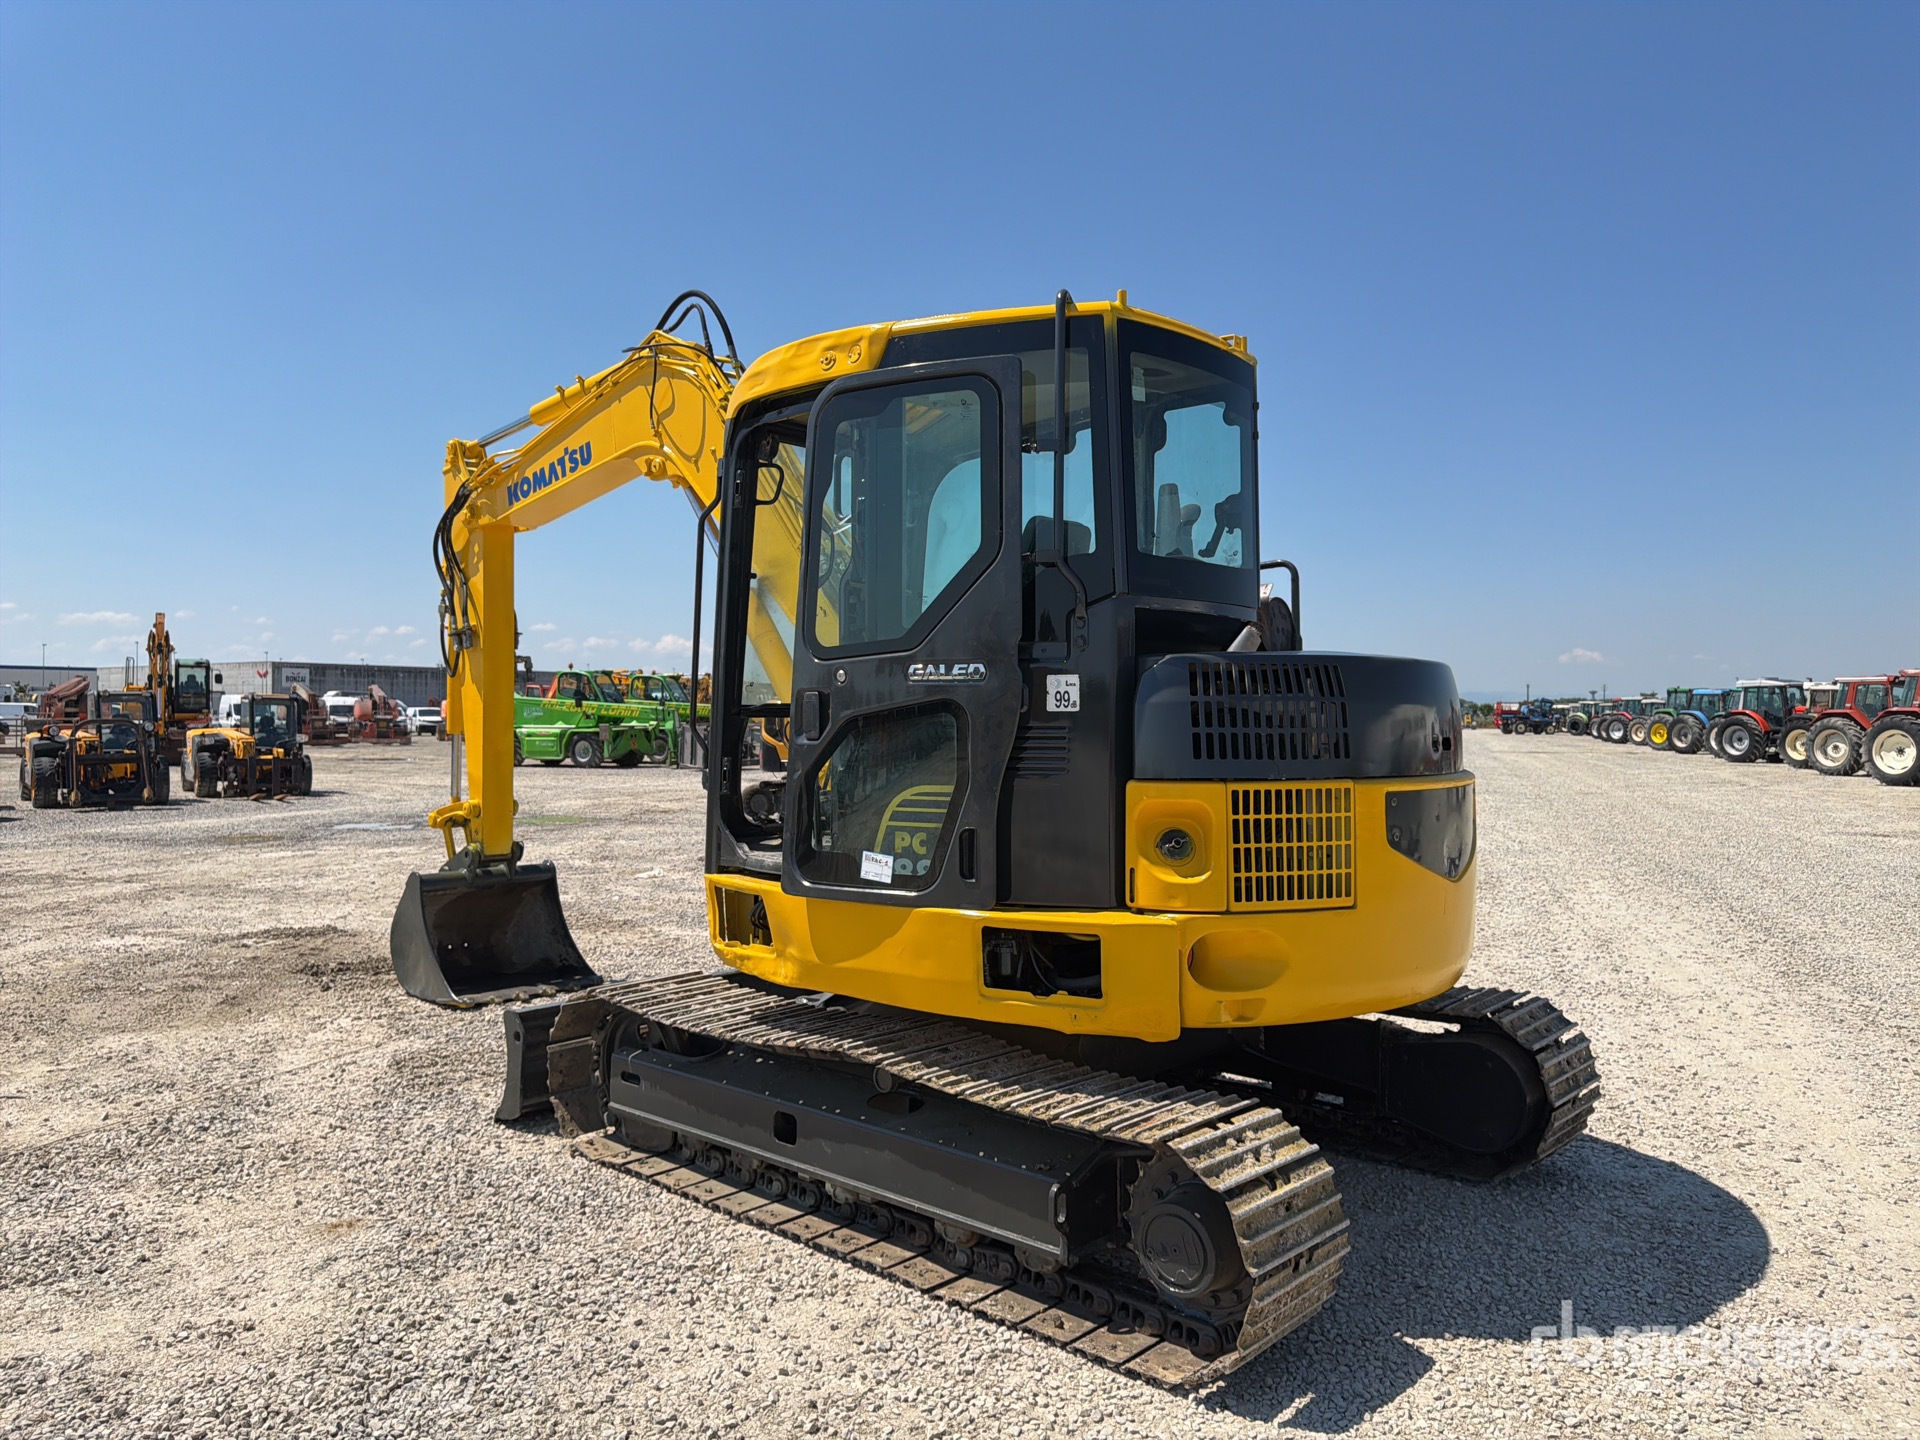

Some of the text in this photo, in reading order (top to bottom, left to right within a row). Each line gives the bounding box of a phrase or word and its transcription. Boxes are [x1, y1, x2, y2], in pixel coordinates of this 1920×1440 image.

[506, 440, 593, 507] KOMATSU
[907, 663, 987, 681] GALEO
[1054, 690, 1070, 708] 99
[894, 831, 927, 854] PC
